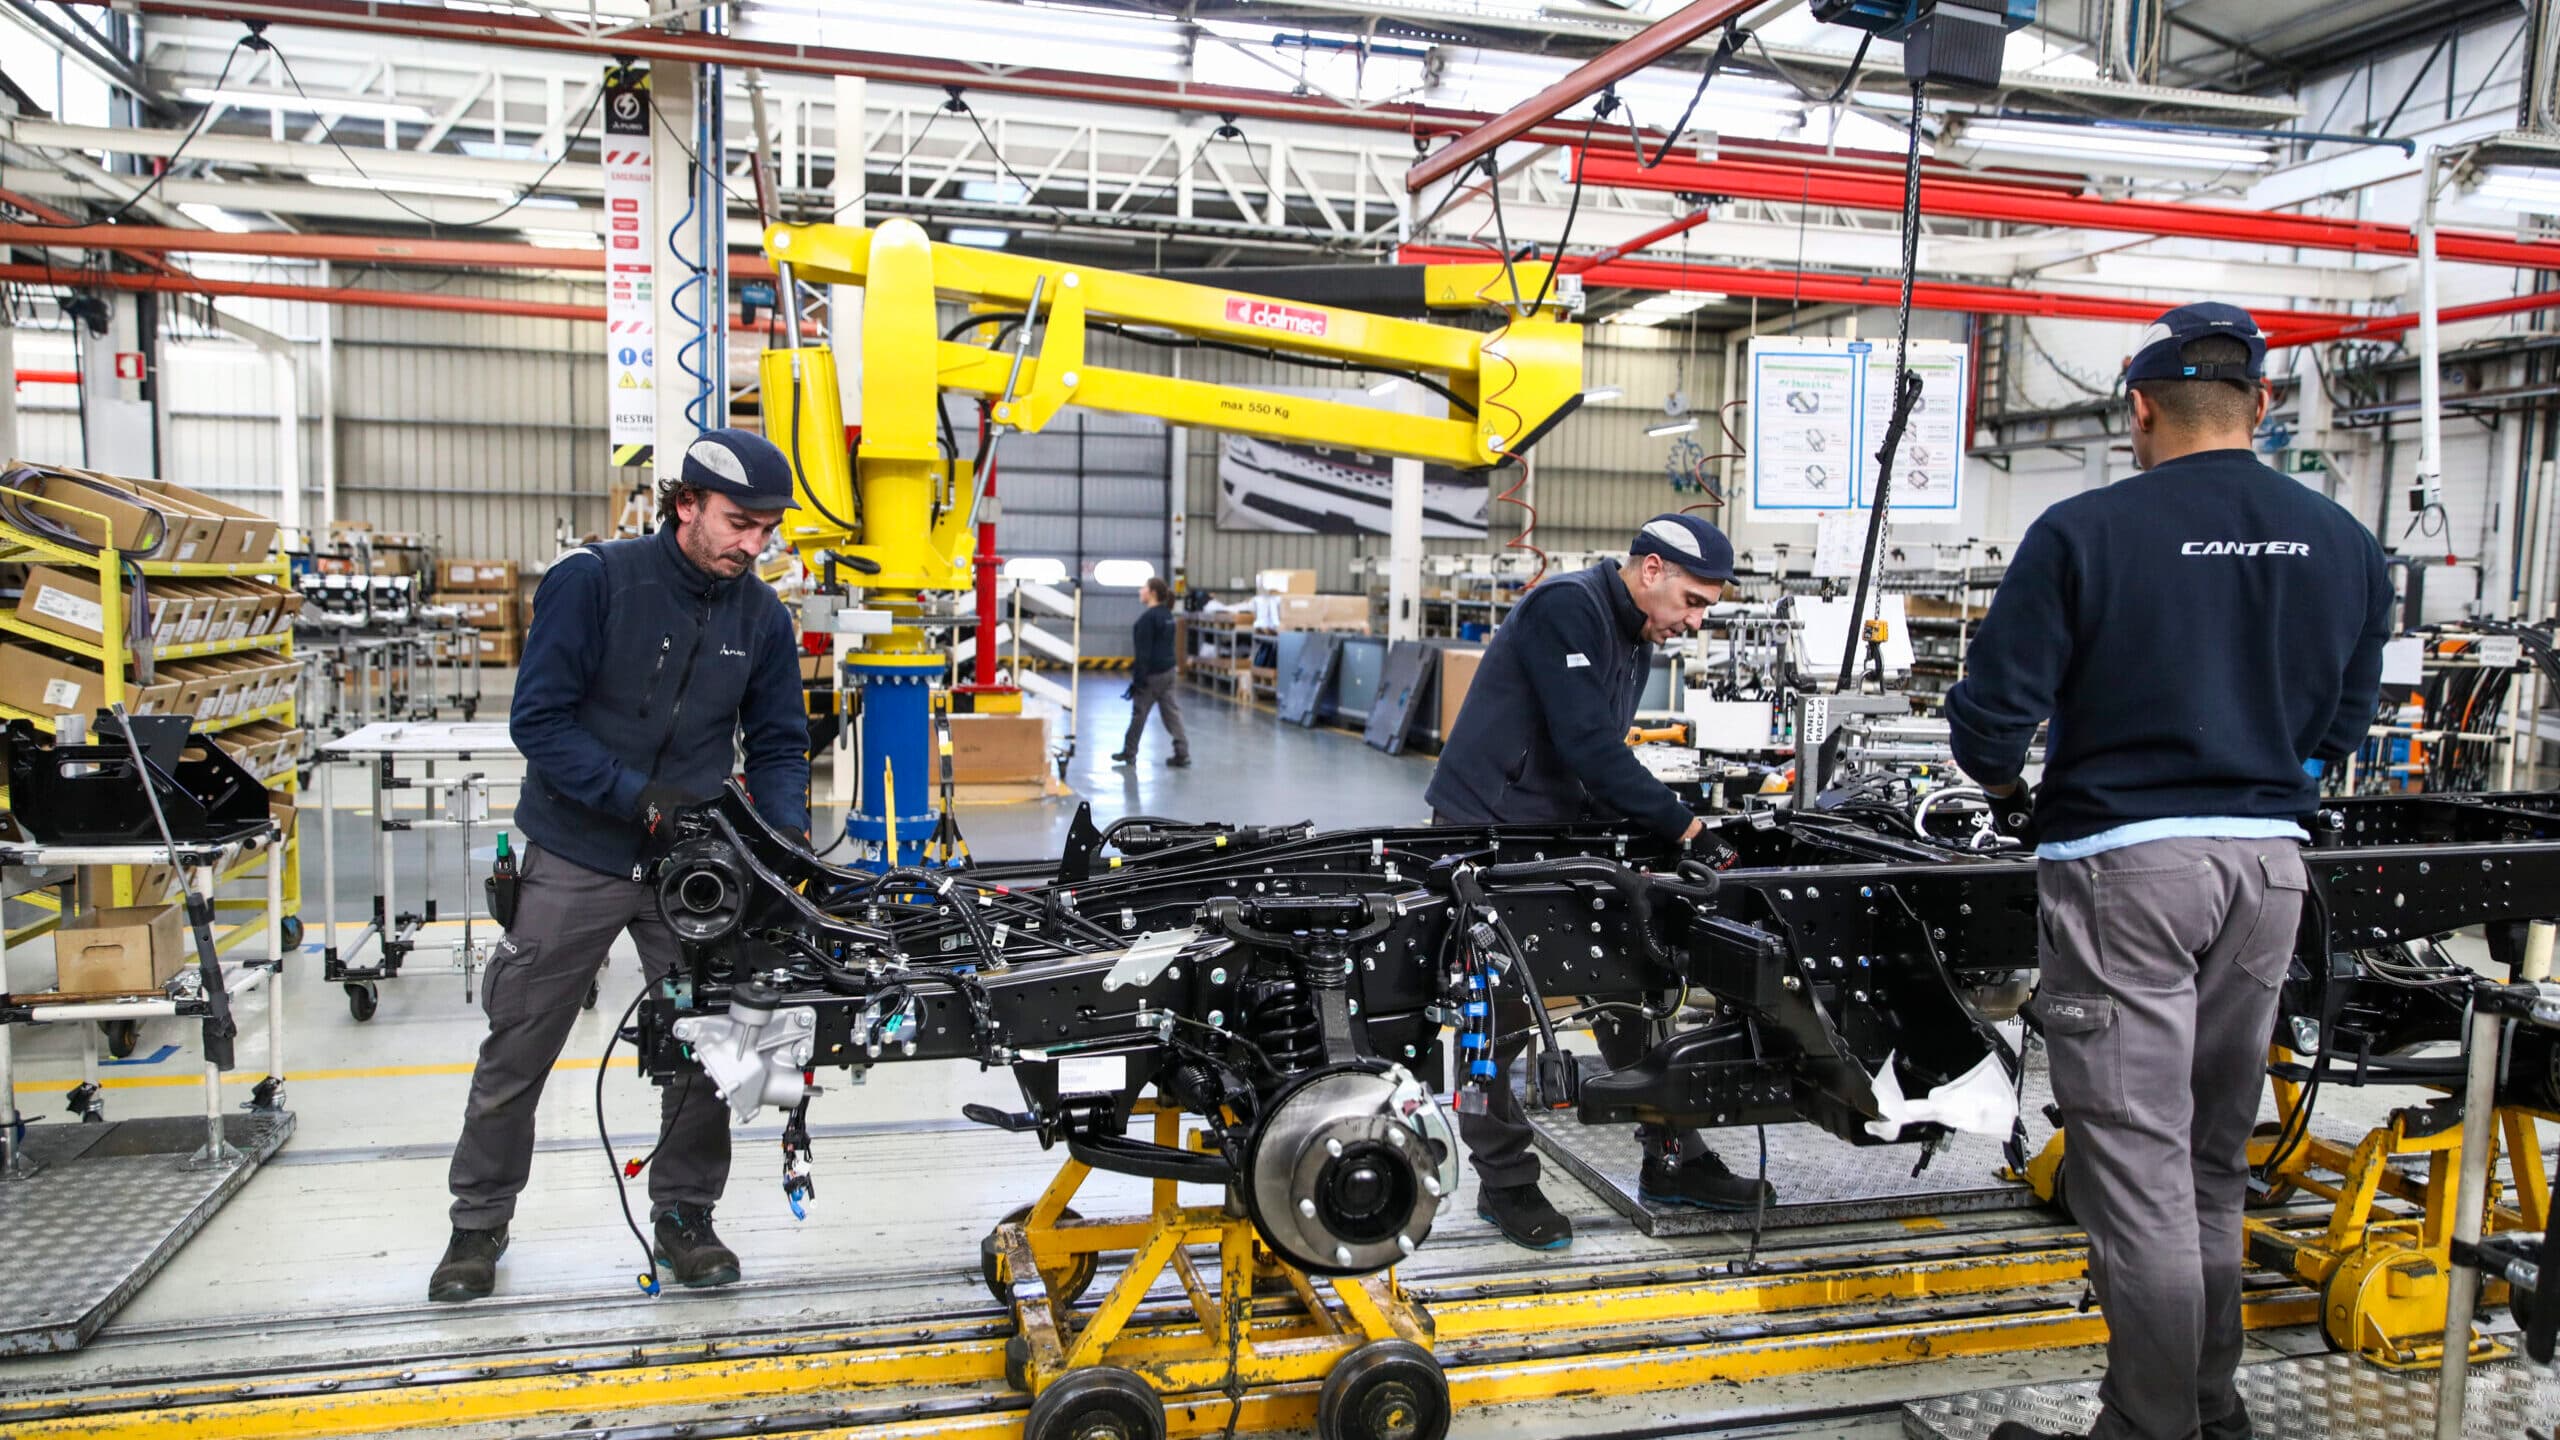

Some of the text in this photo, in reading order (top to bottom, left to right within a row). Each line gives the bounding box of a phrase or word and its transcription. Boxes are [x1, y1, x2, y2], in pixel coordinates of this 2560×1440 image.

[1253, 303, 1324, 335] dalmec
[1220, 399, 1290, 419] max 550 Kg
[2181, 541, 2310, 556] CANTER
[1806, 699, 1815, 742] PANELA
[2056, 1004, 2084, 1018] FUSO
